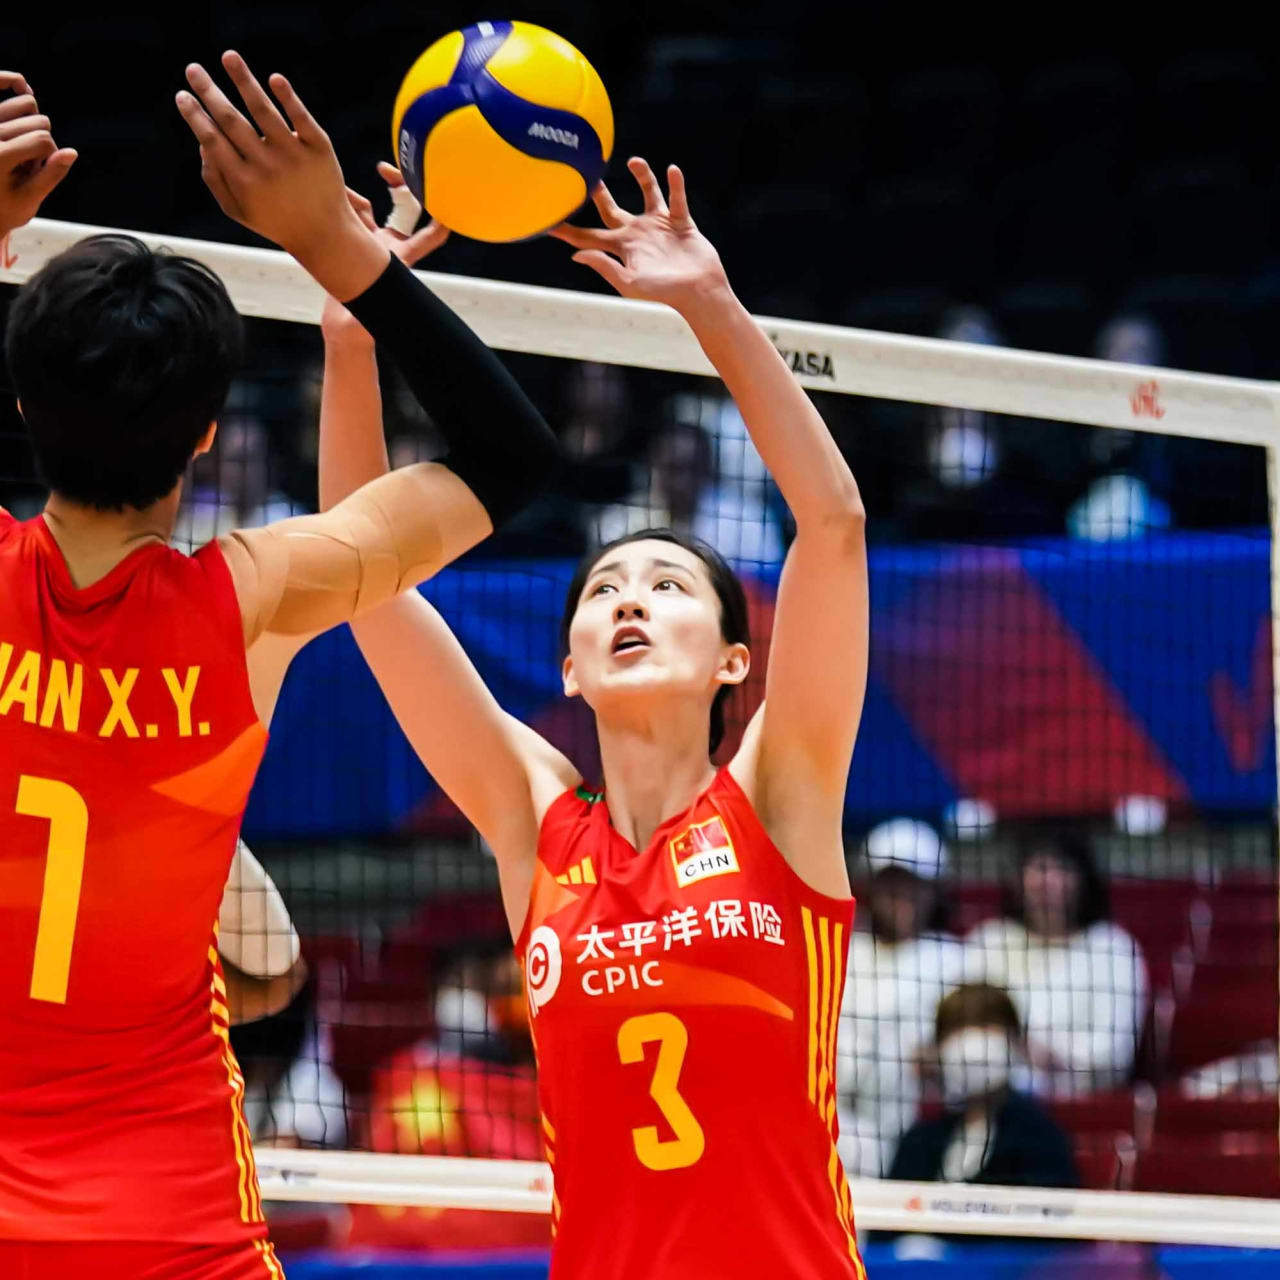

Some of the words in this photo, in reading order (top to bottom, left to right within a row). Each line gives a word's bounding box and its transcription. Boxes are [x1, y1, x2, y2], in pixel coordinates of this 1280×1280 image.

[777, 348, 837, 380] ASA
[16, 774, 89, 1005] 1
[684, 854, 730, 877] CHN
[576, 899, 786, 964] 太平洋保险
[581, 960, 664, 996] CPIC
[617, 1012, 706, 1171] 3
